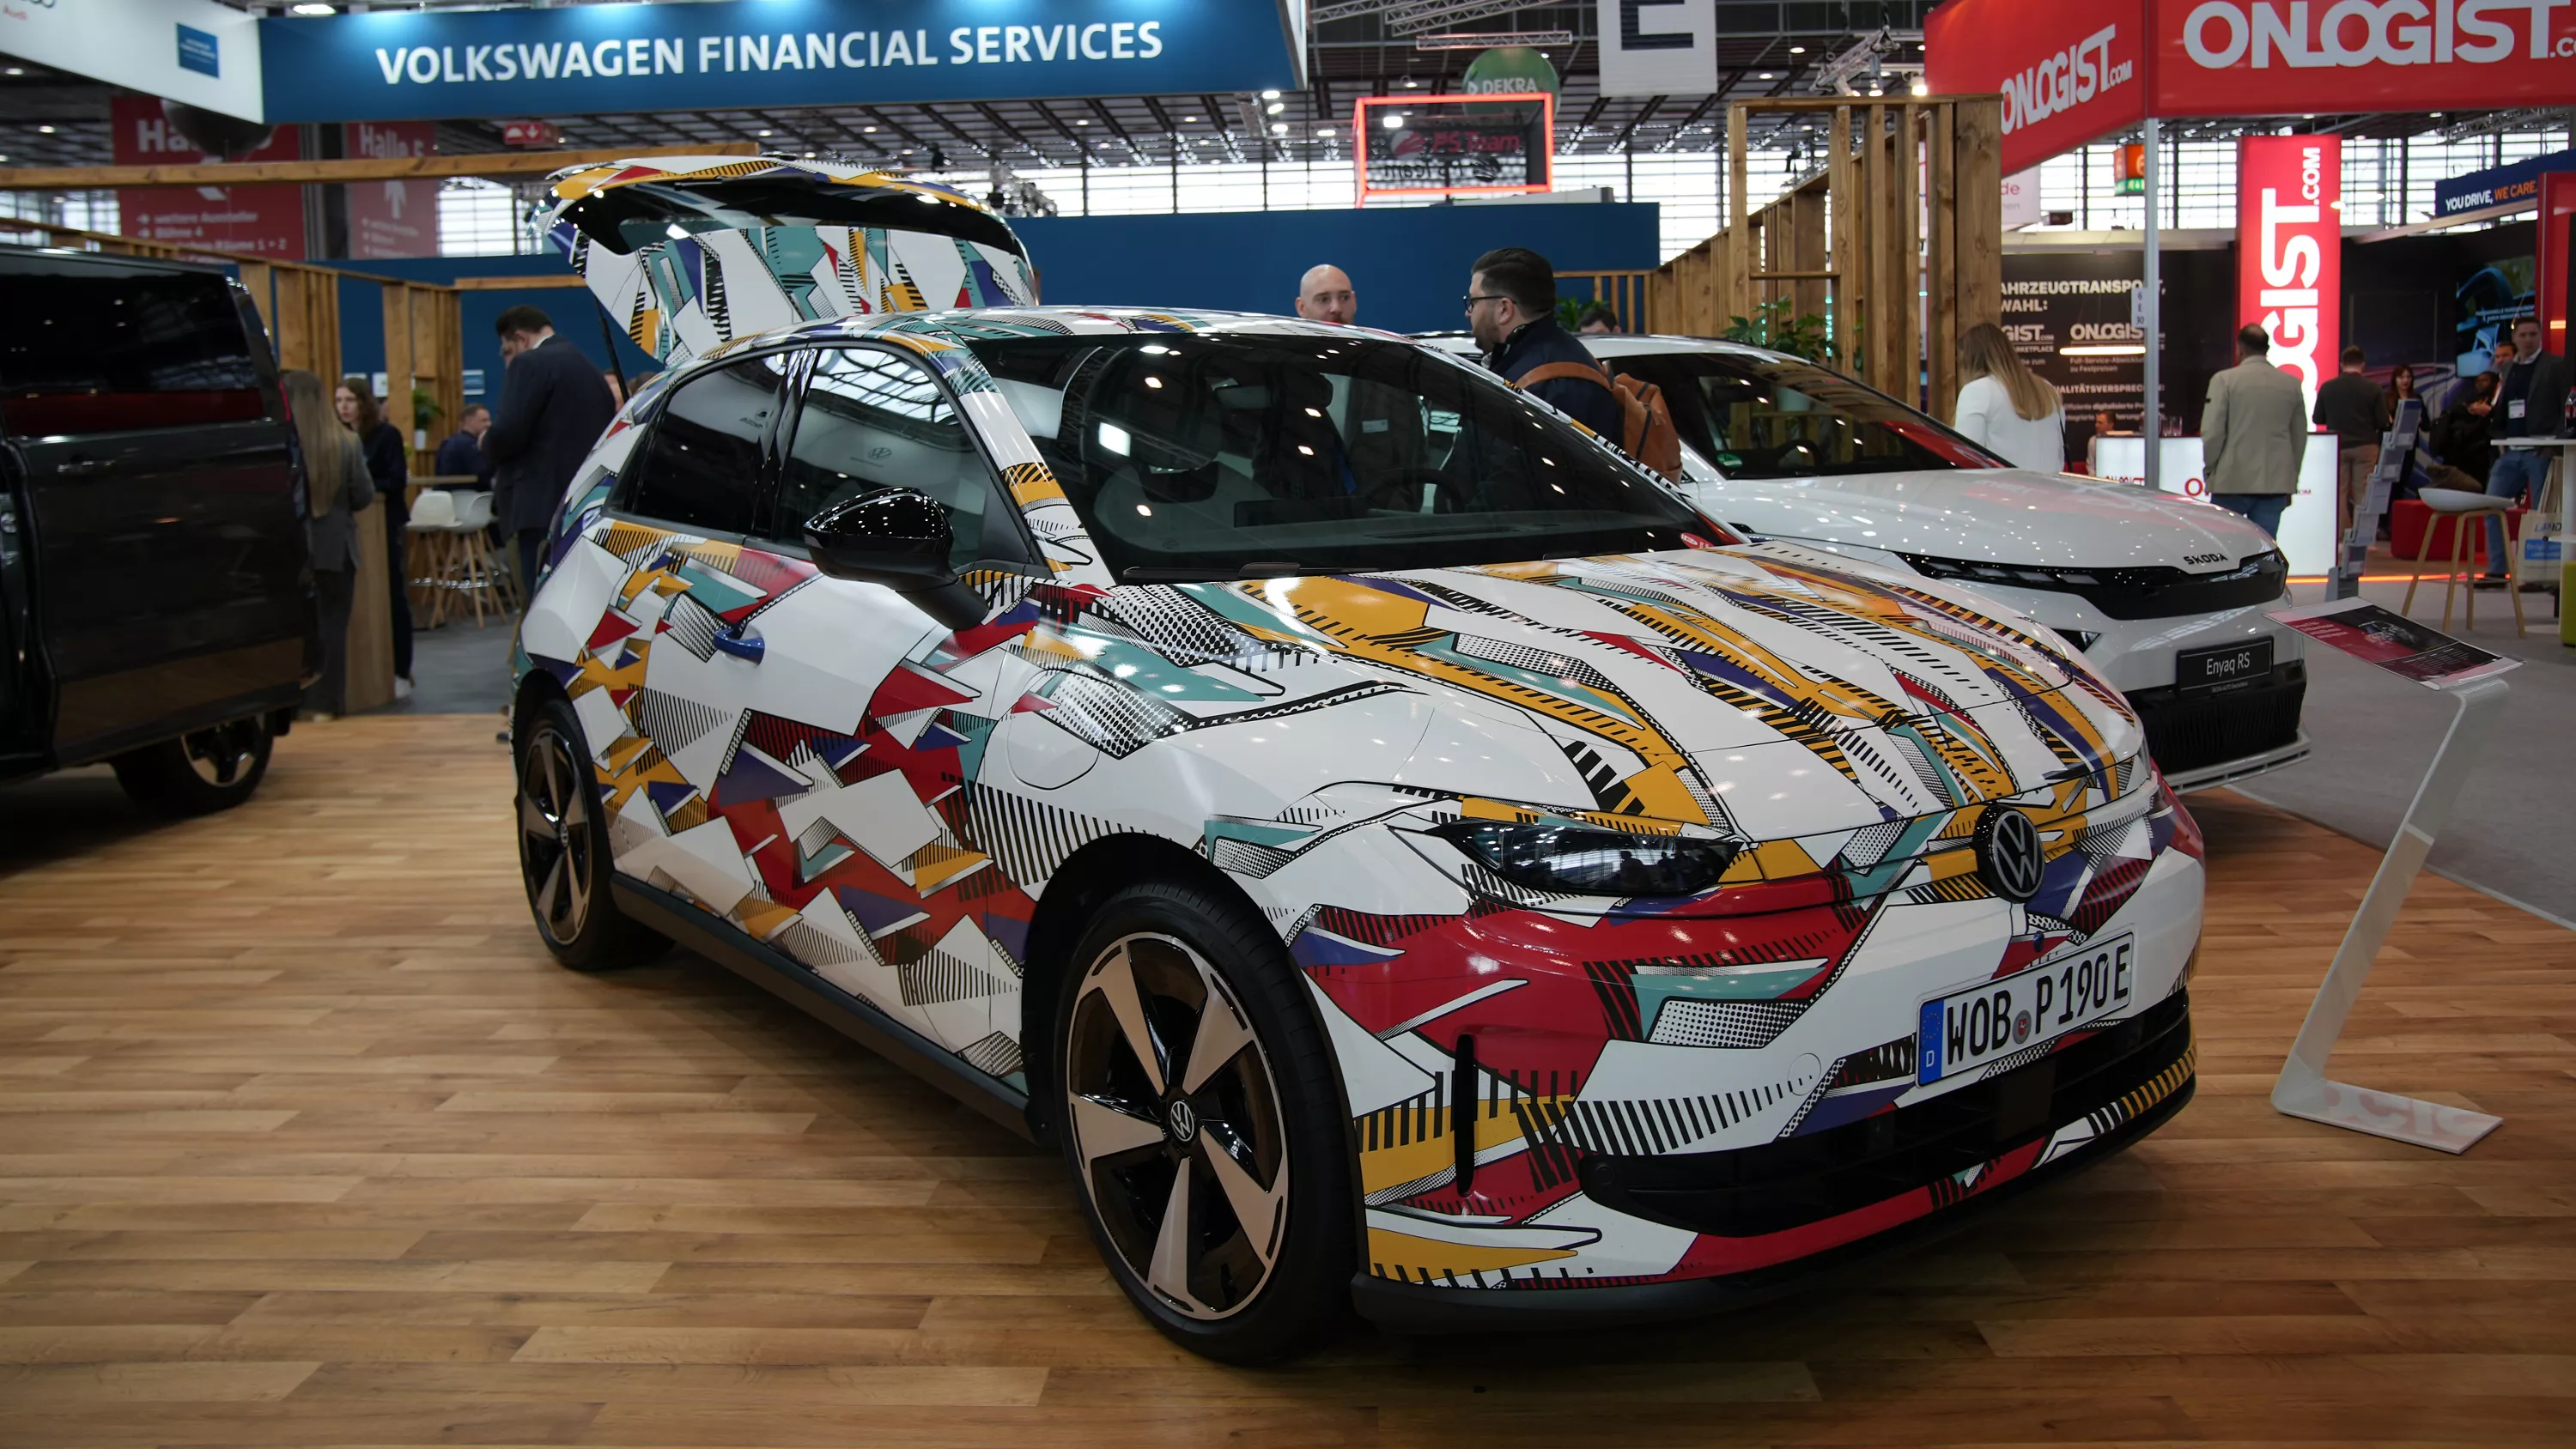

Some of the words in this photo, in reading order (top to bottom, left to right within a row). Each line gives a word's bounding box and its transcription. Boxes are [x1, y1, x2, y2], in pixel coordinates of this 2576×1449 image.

[2183, 0, 2576, 69] ONLOGIST.C
[375, 38, 683, 84] VOLKSWAGEN
[699, 29, 939, 73] FINANCIAL
[950, 21, 1163, 64] SERVICES
[1482, 77, 1538, 94] DEKRA
[1431, 131, 1459, 153] PS
[1465, 130, 1521, 152] Team
[2445, 195, 2464, 211] YOU
[2464, 190, 2494, 209] DRIVE,
[2494, 185, 2509, 200] WE
[2510, 180, 2538, 197] CARE.
[2206, 658, 2235, 677] Enyaq
[2238, 652, 2251, 669] RS
[1947, 990, 2011, 1065] WOB
[1925, 1051, 1935, 1068] D
